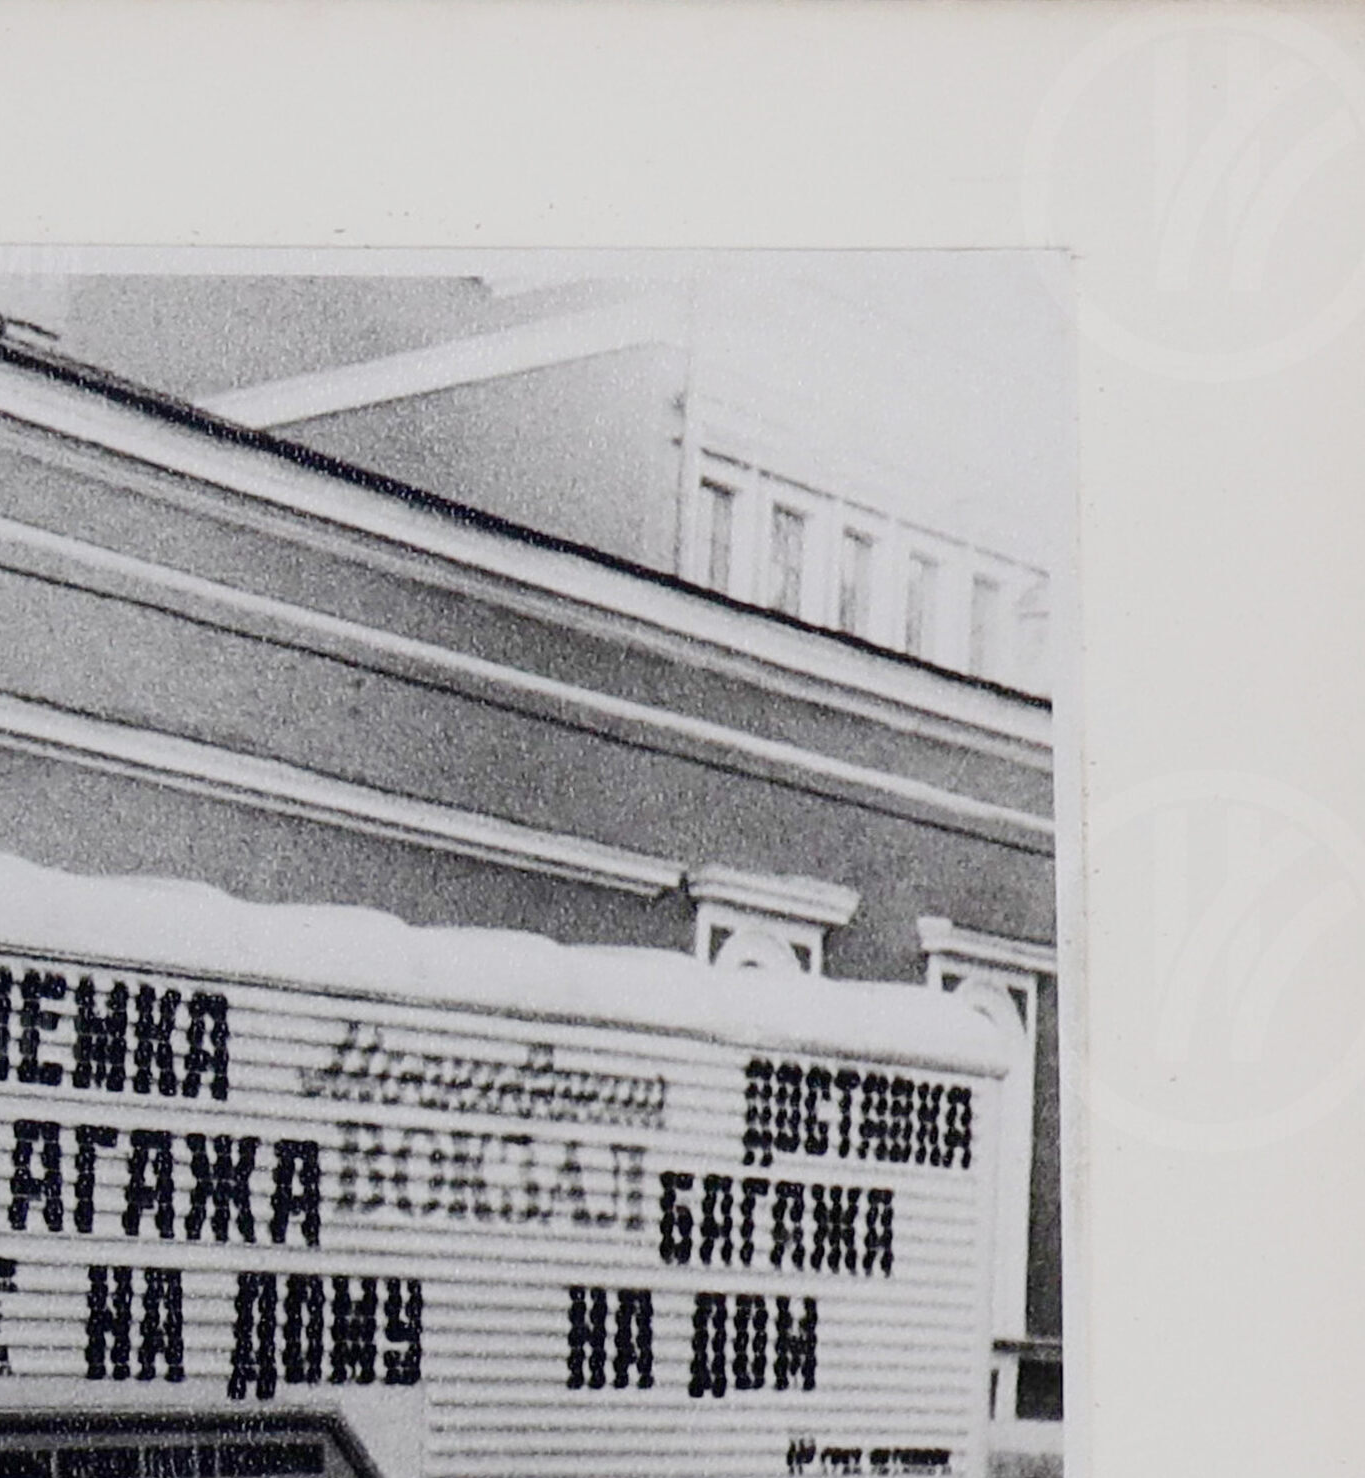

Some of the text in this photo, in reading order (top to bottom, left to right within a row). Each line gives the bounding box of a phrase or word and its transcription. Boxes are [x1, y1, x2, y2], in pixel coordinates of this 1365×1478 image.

[742, 1057, 972, 1169] ДОСТАВКА
[660, 1171, 895, 1278] БАГАЖА
[83, 1264, 423, 1400] НА ДОМУ
[567, 1285, 818, 1398] НА ДОМ
